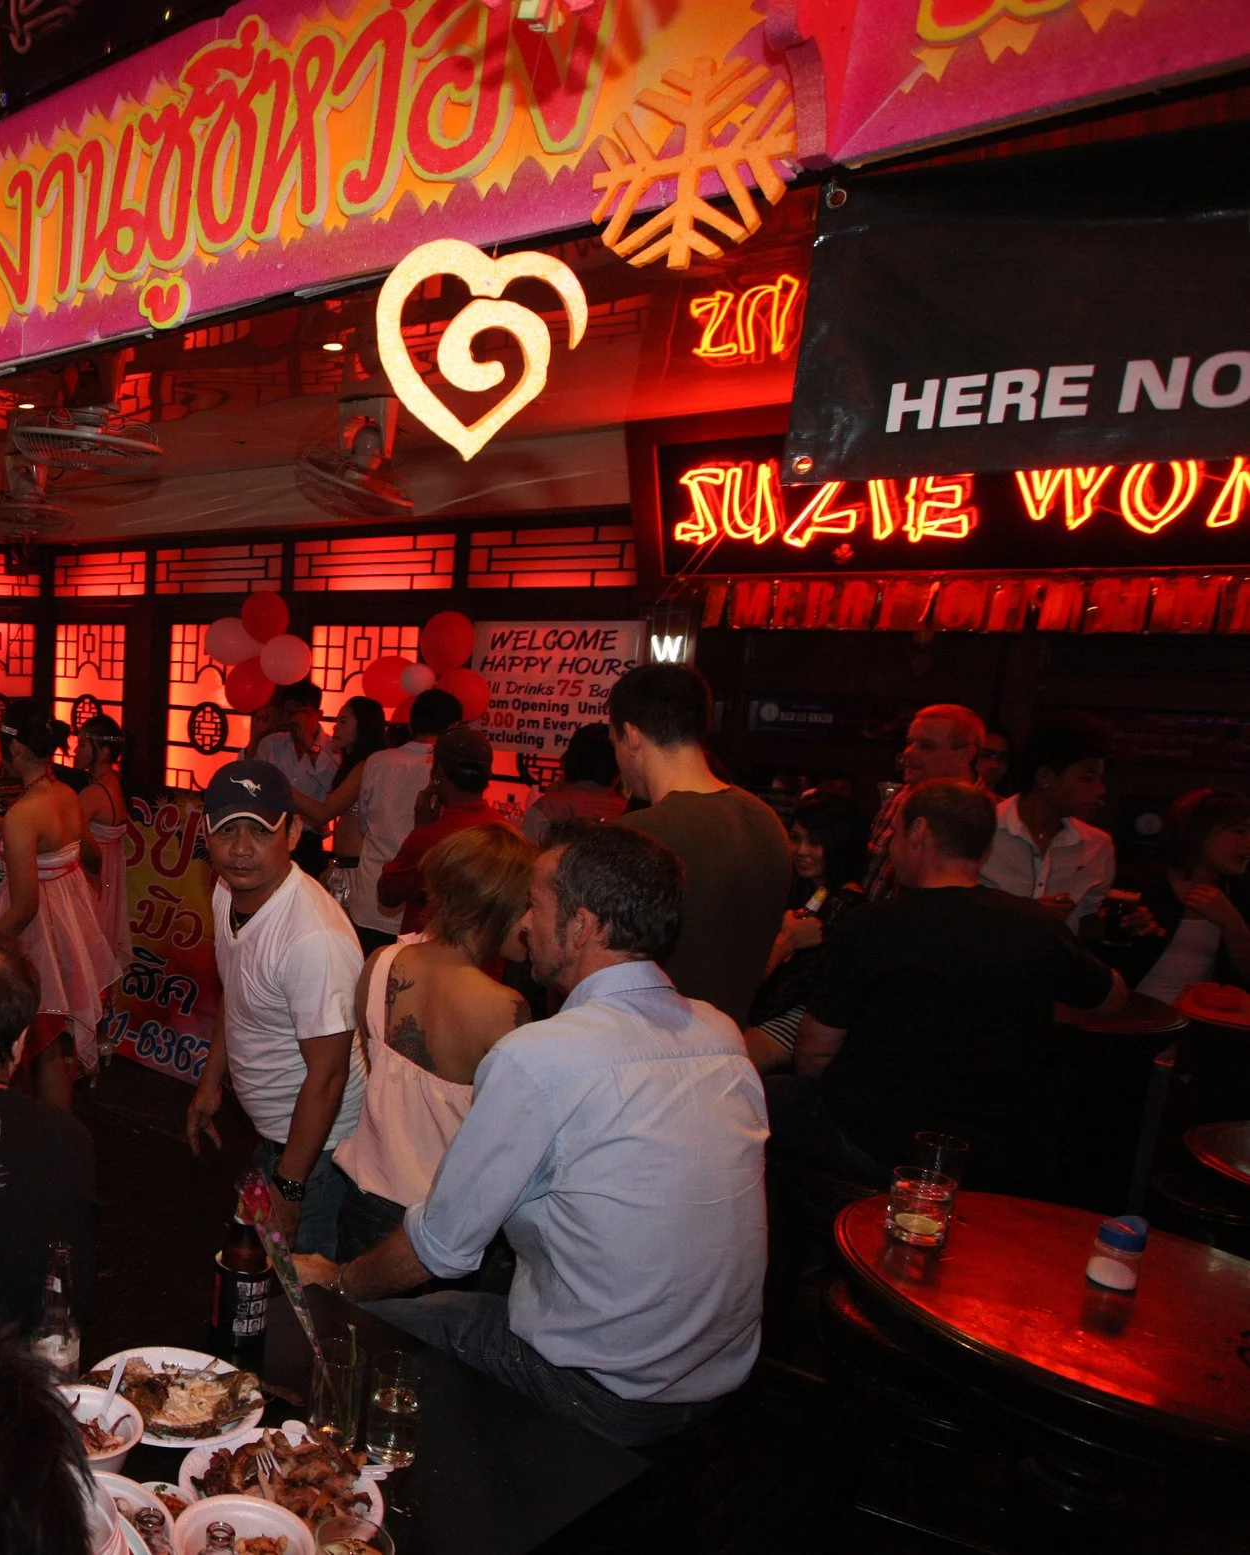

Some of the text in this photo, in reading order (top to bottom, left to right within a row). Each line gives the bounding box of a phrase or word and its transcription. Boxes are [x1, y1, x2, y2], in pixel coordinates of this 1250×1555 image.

[885, 364, 1095, 433] HERE
[490, 629, 618, 651] WELCOME
[651, 634, 684, 662] W
[479, 655, 637, 677] HAPPY HOURS
[506, 681, 554, 696] Drinks
[557, 679, 584, 697] 75
[512, 698, 570, 716] Opening
[481, 711, 515, 728] 9.00
[517, 718, 540, 731] pm
